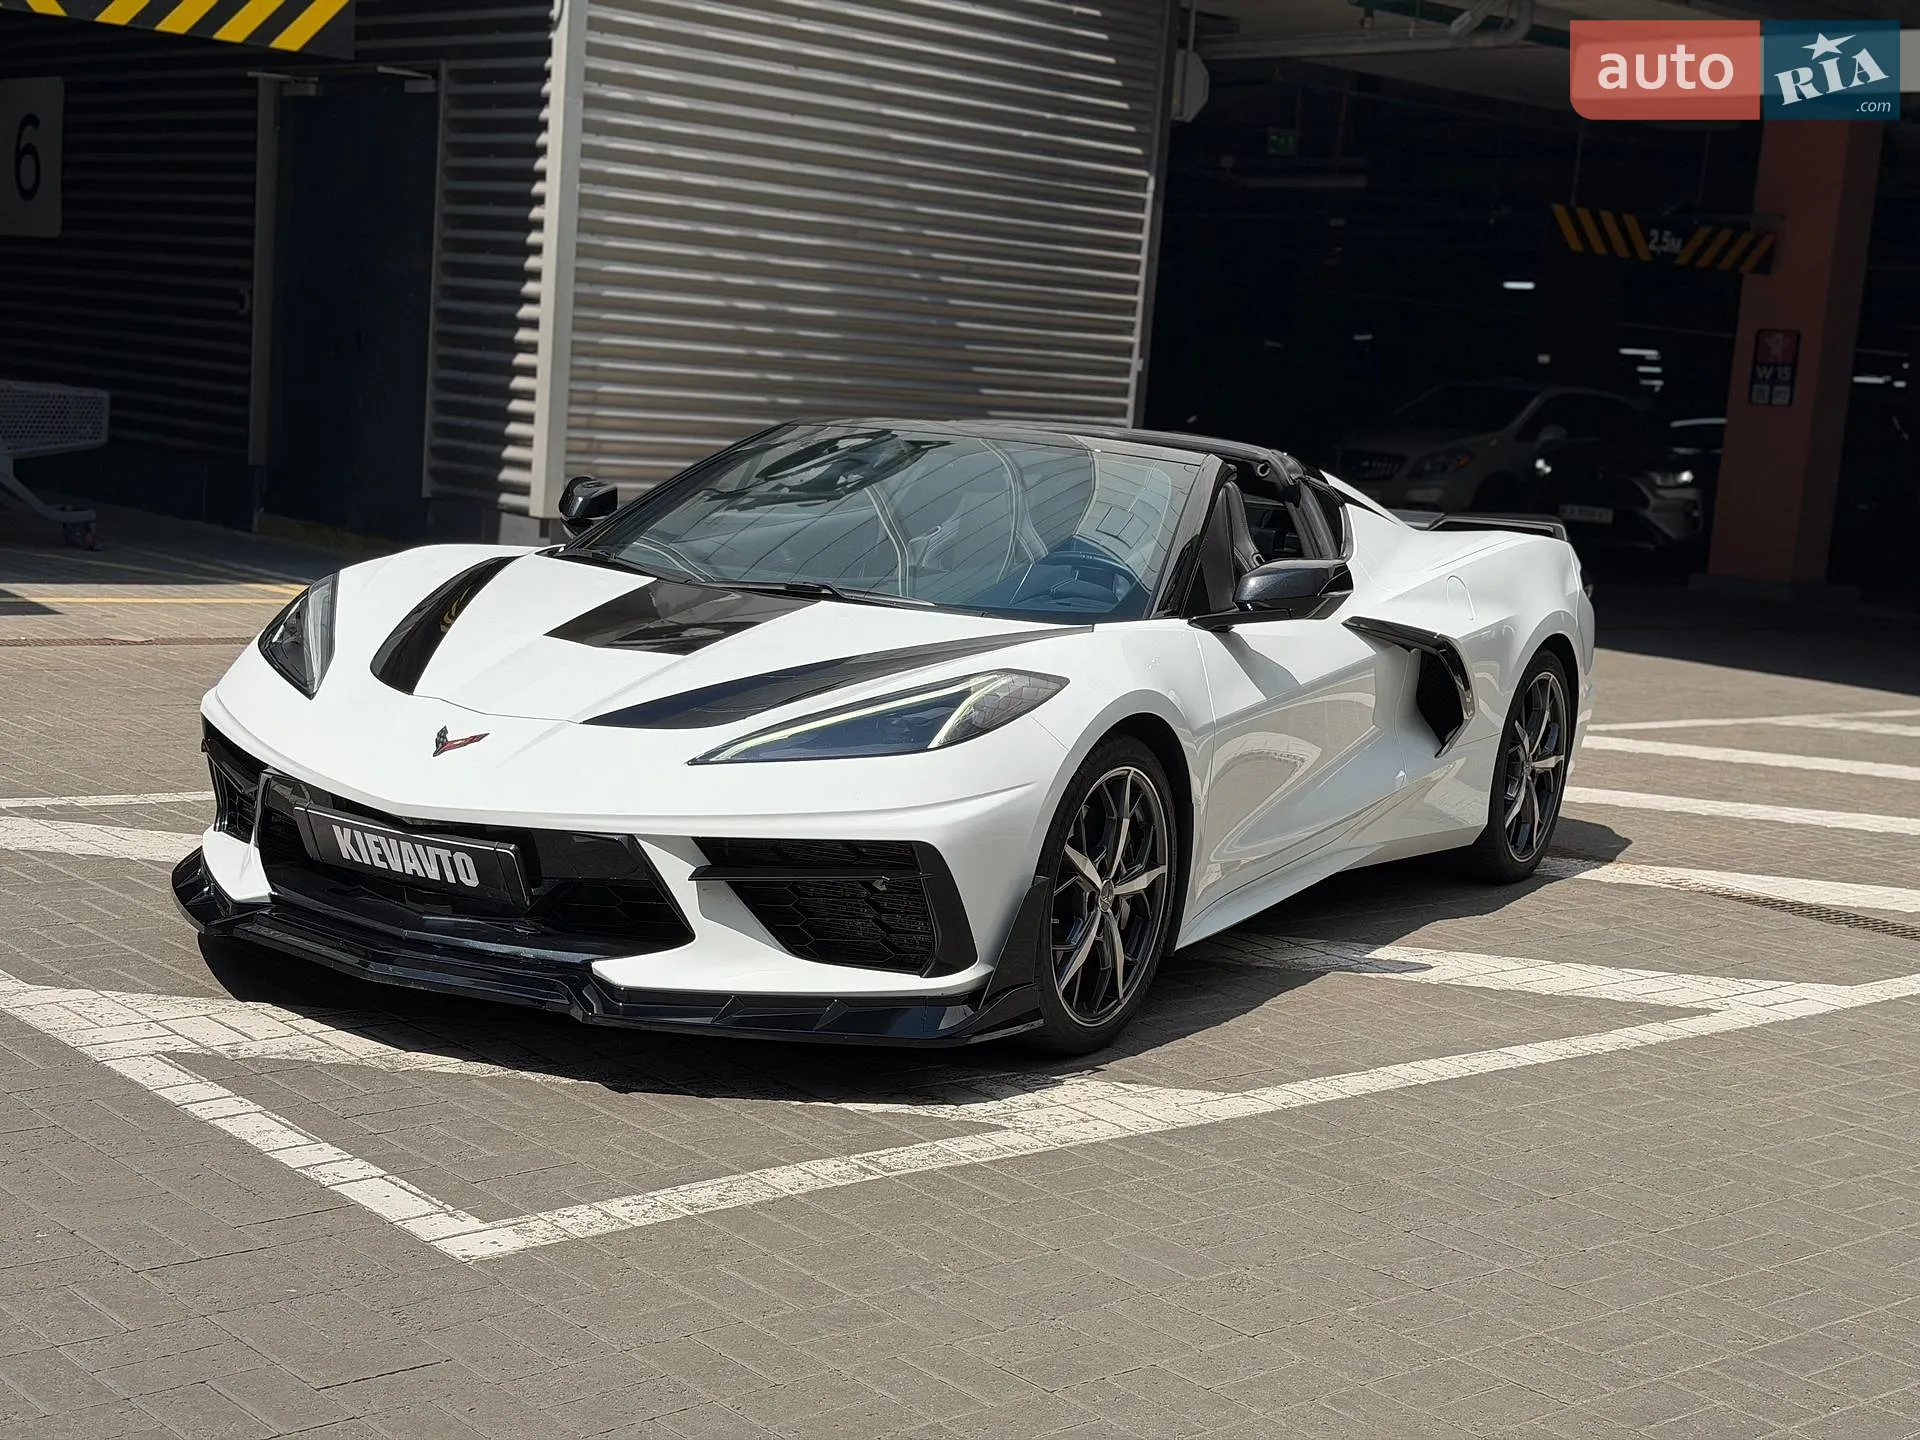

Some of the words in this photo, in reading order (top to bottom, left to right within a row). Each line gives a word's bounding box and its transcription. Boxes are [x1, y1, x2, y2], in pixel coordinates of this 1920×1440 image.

[15, 112, 41, 202] 6
[1755, 364, 1775, 380] W
[1776, 365, 1792, 381] 15
[331, 824, 480, 888] KIEVAVTO
